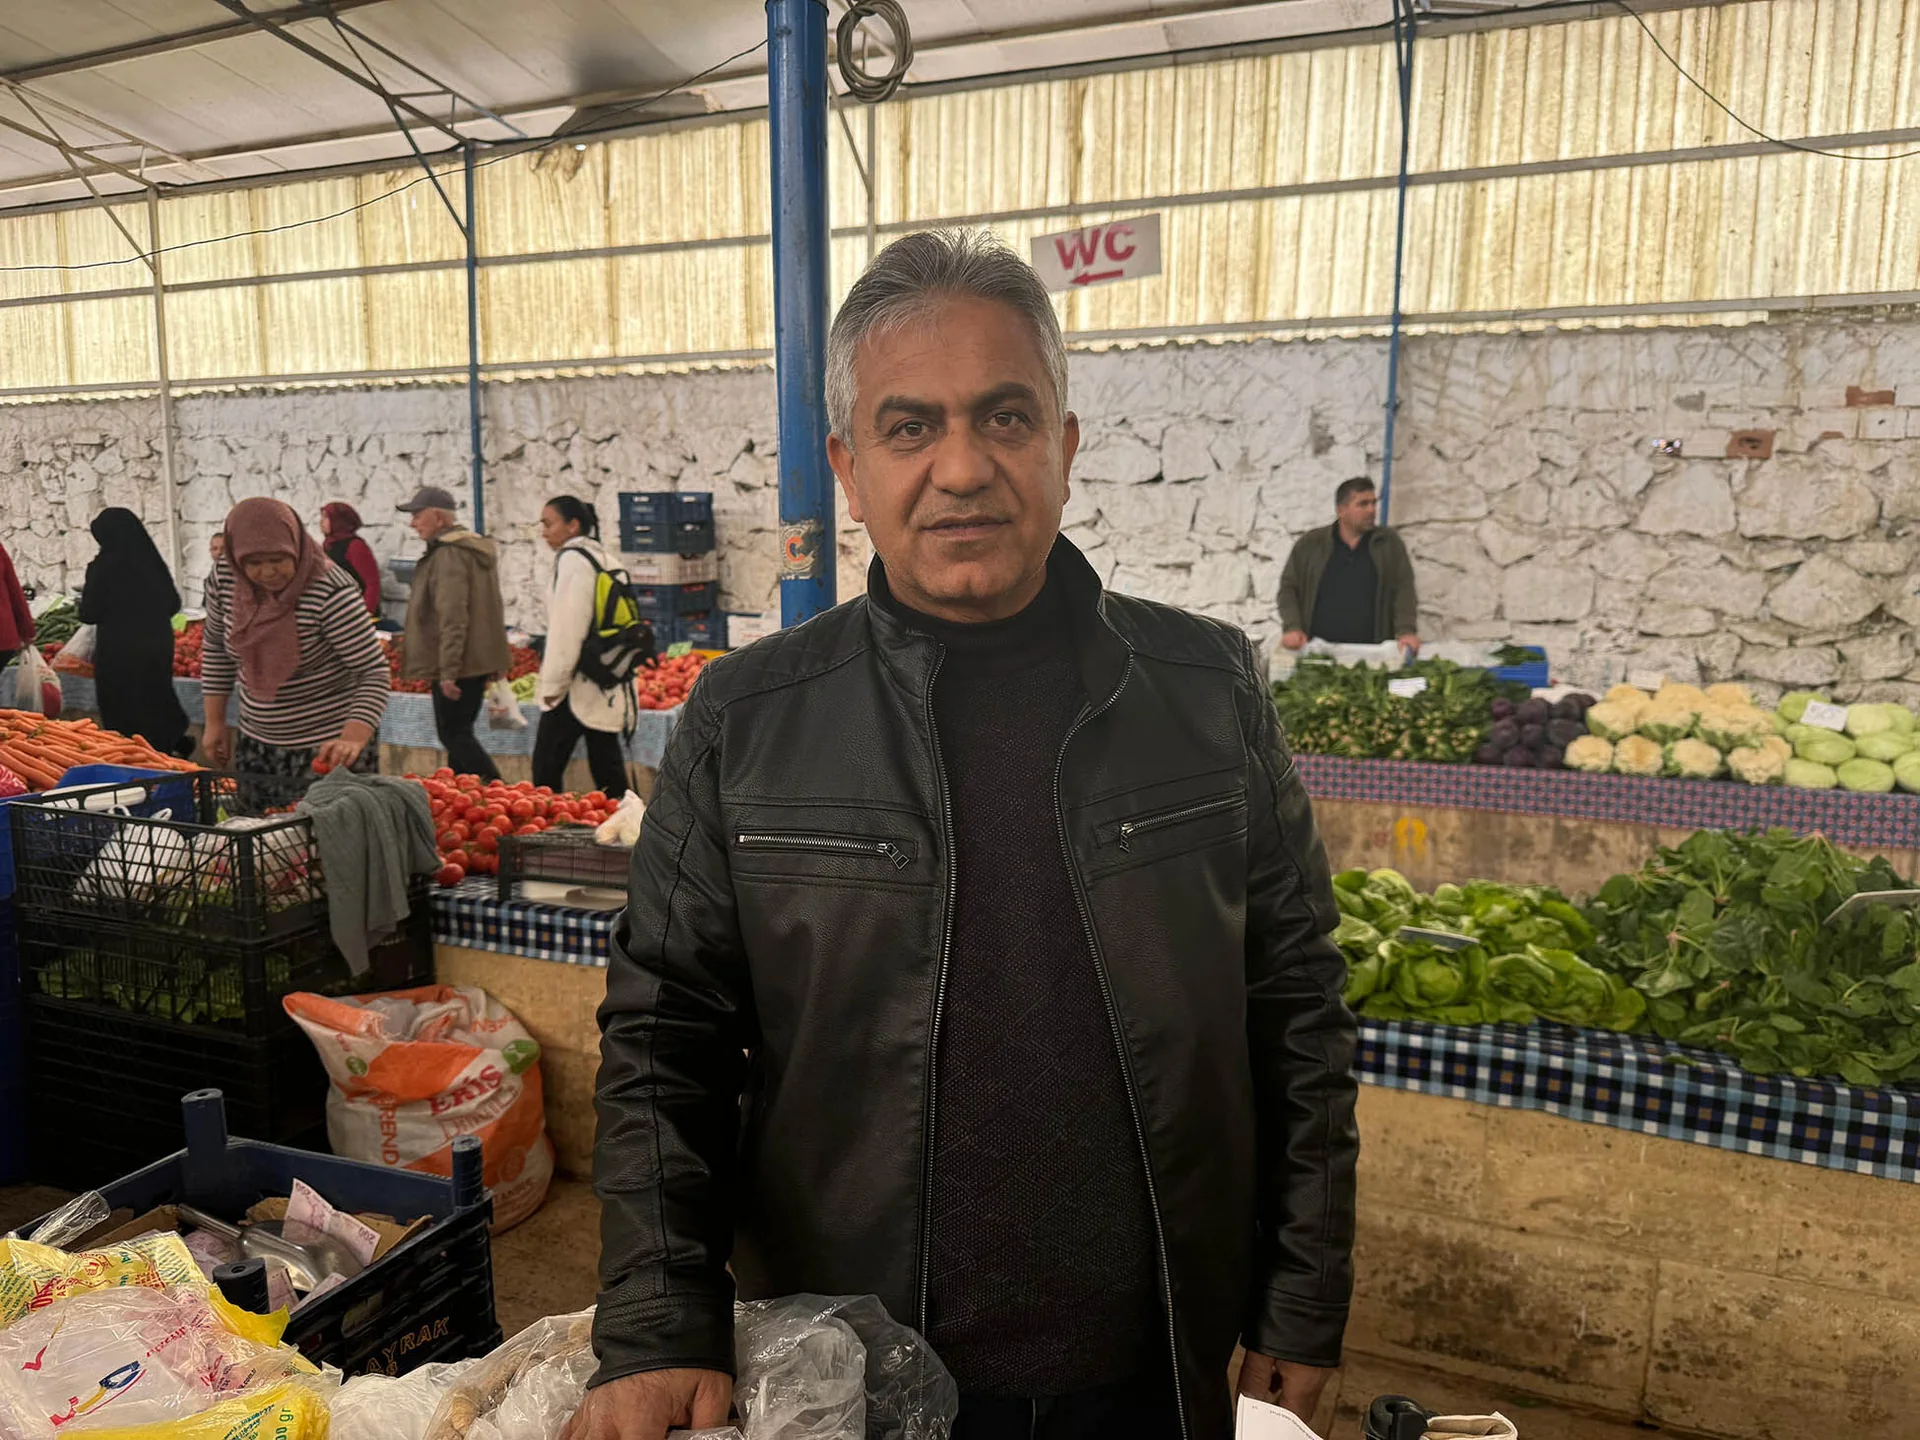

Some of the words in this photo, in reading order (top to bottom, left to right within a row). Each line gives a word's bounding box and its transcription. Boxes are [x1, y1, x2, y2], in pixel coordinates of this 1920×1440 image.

[1054, 223, 1137, 270] WC
[357, 1227, 377, 1245] 200
[350, 1316, 450, 1376] AYRAK
[279, 1407, 294, 1422] gr
